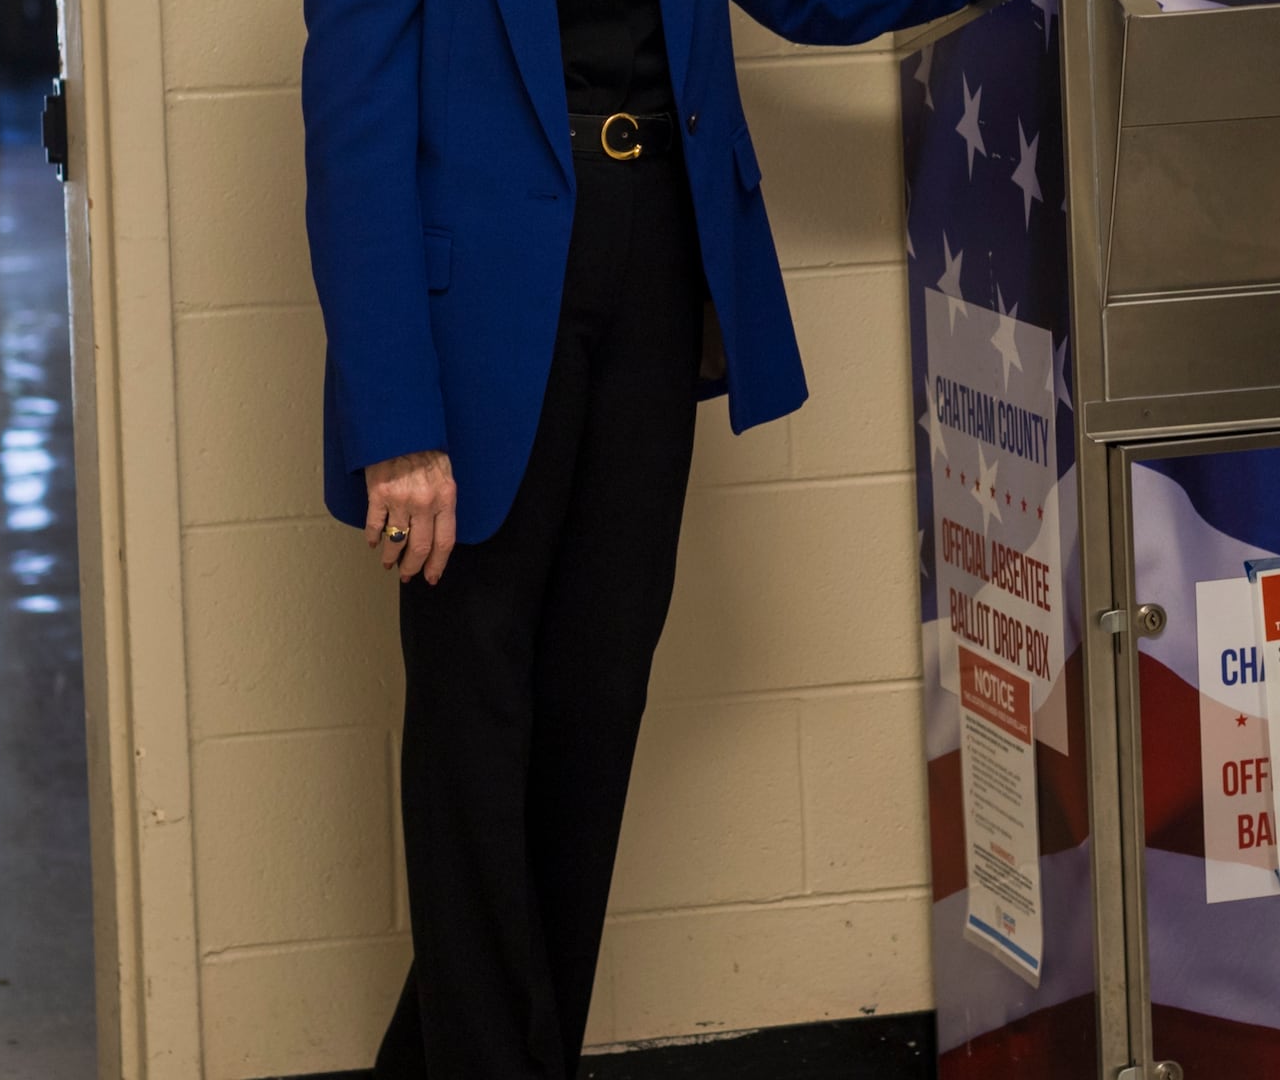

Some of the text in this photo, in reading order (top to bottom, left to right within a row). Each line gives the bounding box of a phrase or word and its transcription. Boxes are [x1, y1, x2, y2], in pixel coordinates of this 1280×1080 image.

[936, 375, 1049, 468] CHATHAM COUNTY
[942, 517, 1051, 612] OFFICIAL ABSENTEE
[950, 587, 1051, 682] BALLOT DROP BOX
[974, 665, 1016, 713] NOTICE
[1222, 757, 1274, 797] OFF
[1237, 811, 1277, 850] BA
